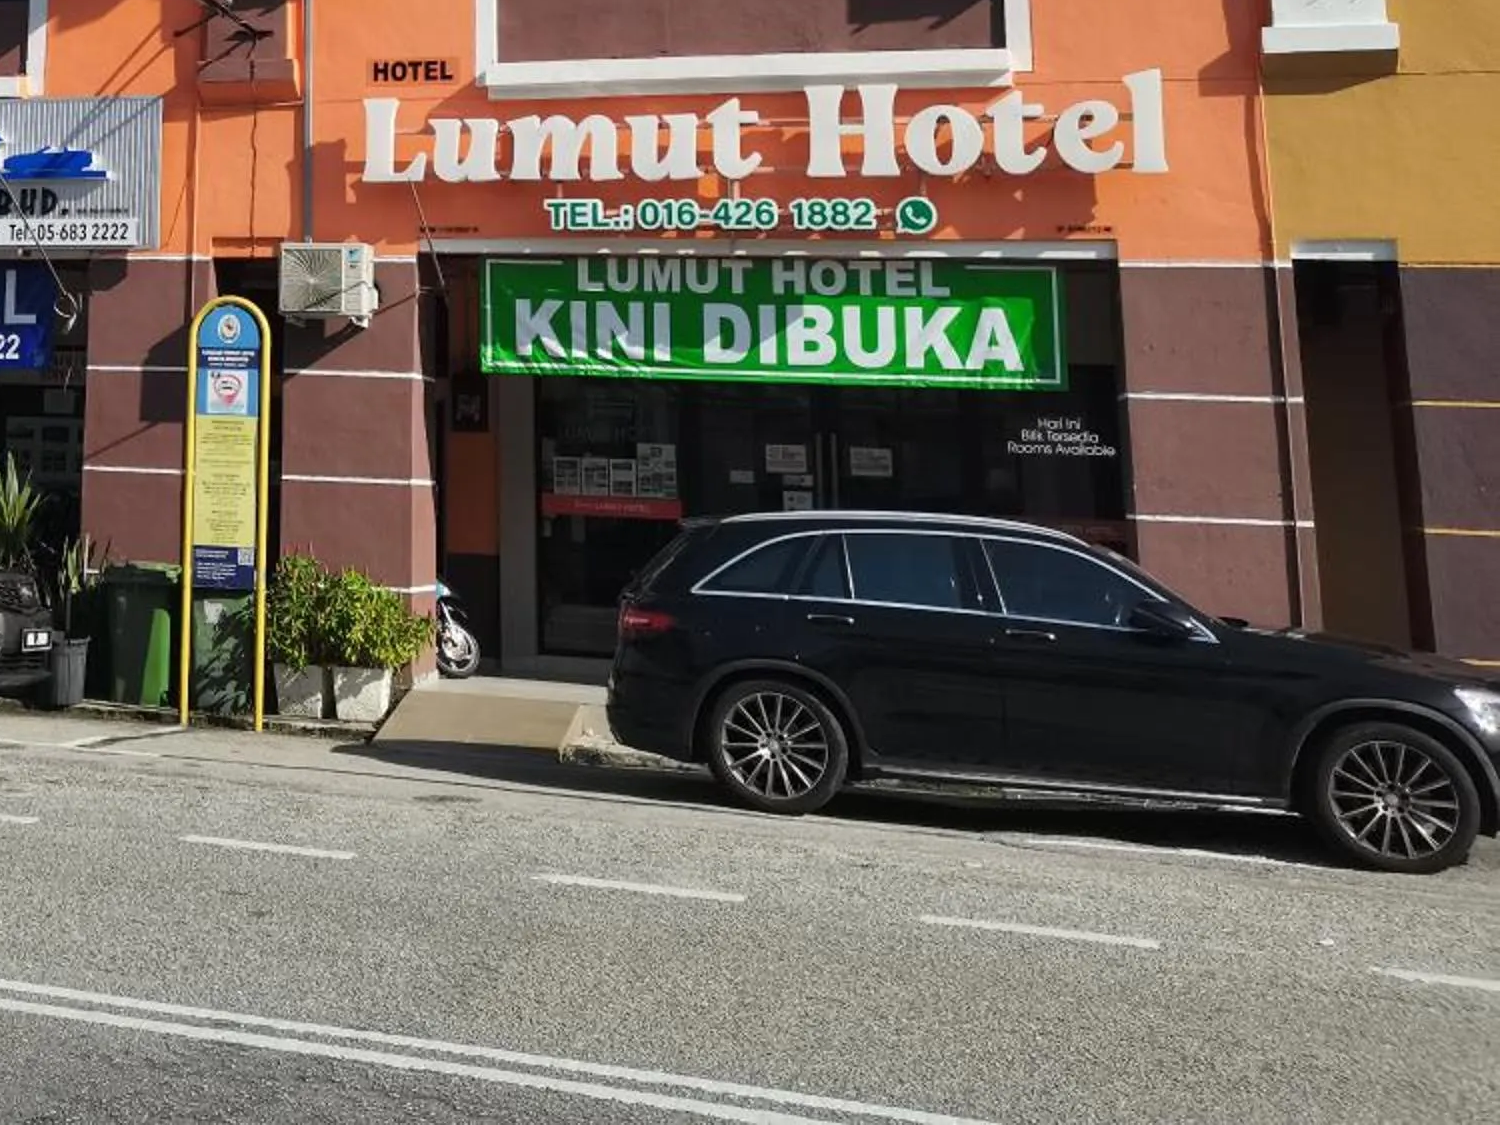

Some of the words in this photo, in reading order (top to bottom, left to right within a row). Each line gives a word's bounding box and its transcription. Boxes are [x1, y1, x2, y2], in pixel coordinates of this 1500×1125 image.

[372, 60, 454, 83] HOTEL
[362, 96, 764, 184] Lumut
[804, 68, 1170, 178] Hotel
[637, 198, 778, 229] 016-426
[792, 197, 876, 229] 1882
[91, 222, 129, 241] 2222
[576, 257, 752, 295] LUMUT
[770, 261, 952, 300] HOTEL
[514, 298, 674, 363] KINI
[702, 299, 1027, 373] DIBUKA
[1037, 416, 1063, 430] Hari
[1065, 416, 1081, 430] Ini
[1021, 428, 1045, 442] Bilik
[1046, 430, 1100, 444] Tersedia
[1007, 440, 1053, 454] Rooms
[1055, 443, 1117, 457] Available
